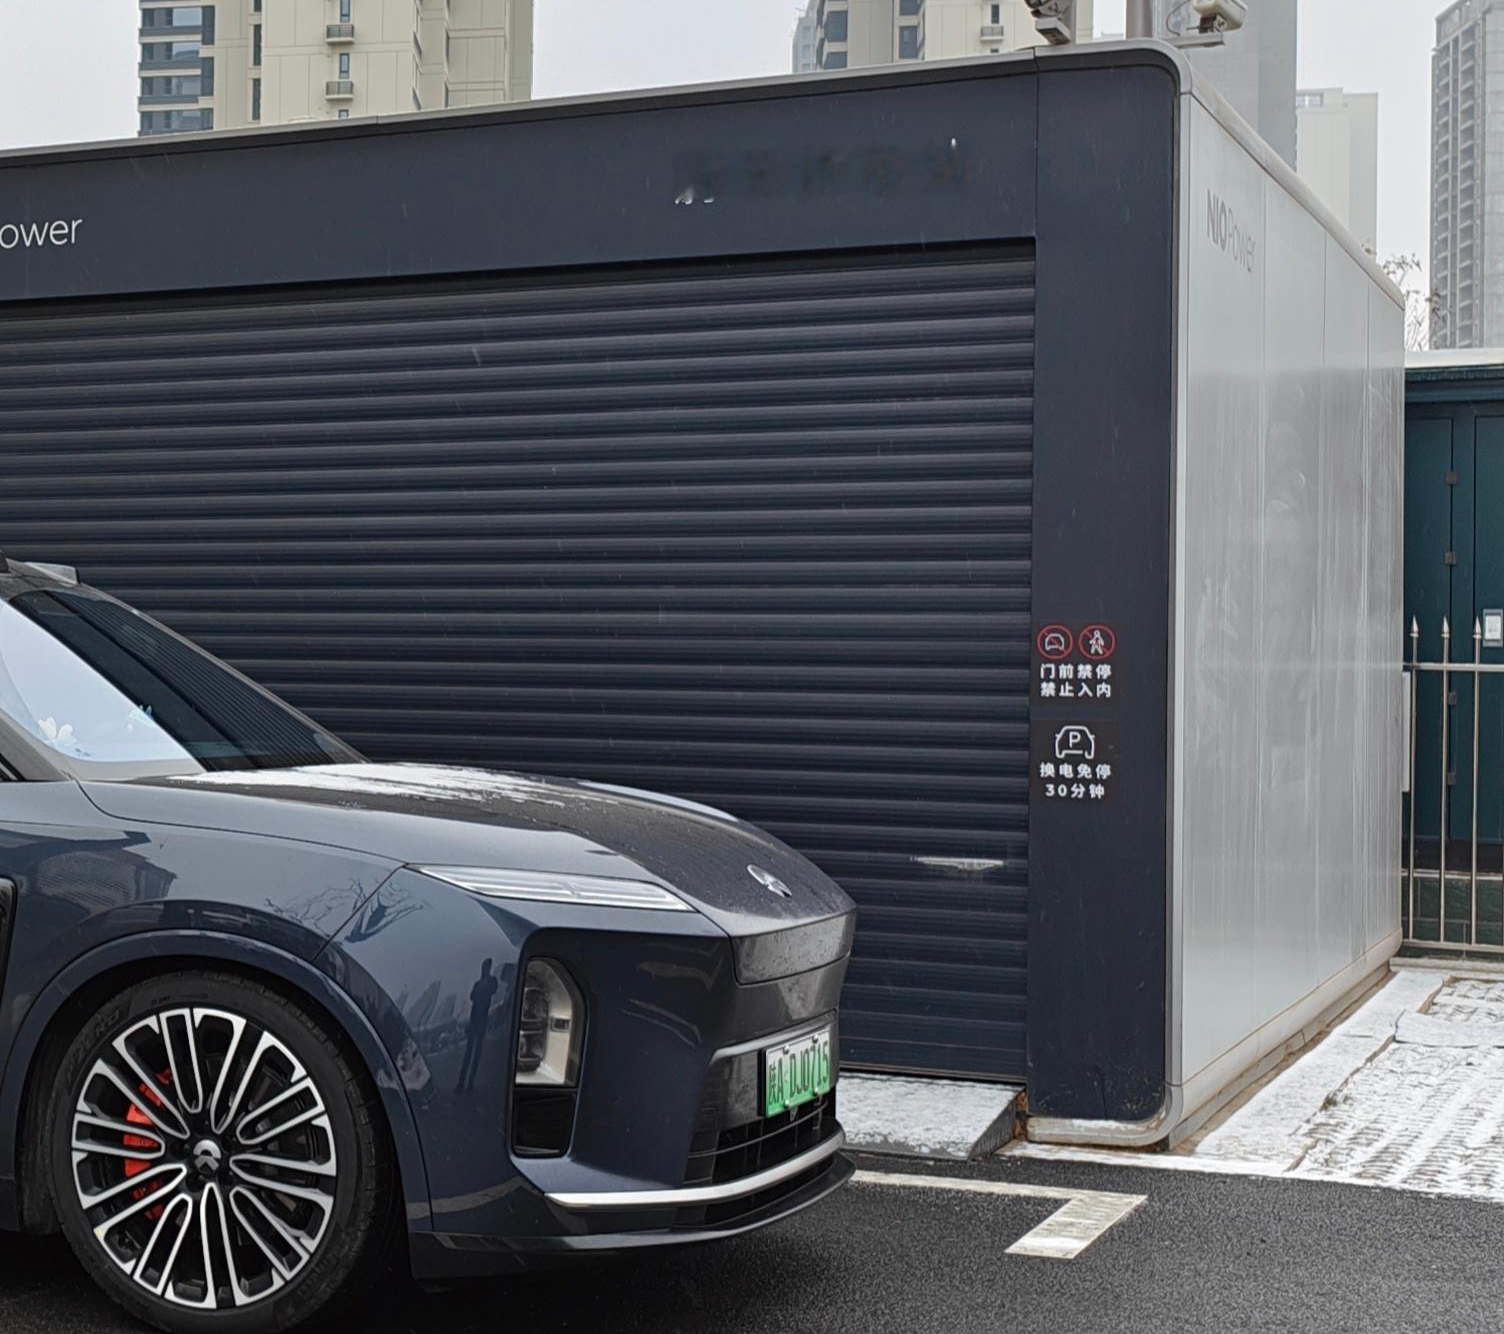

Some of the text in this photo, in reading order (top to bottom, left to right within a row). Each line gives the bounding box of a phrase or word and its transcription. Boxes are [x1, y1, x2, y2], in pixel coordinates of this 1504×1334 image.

[1039, 663, 1113, 680] 门前禁停
[1039, 681, 1112, 698] 禁止入内
[1039, 762, 1112, 780] 换电免停
[1045, 783, 1106, 799] 30分钟
